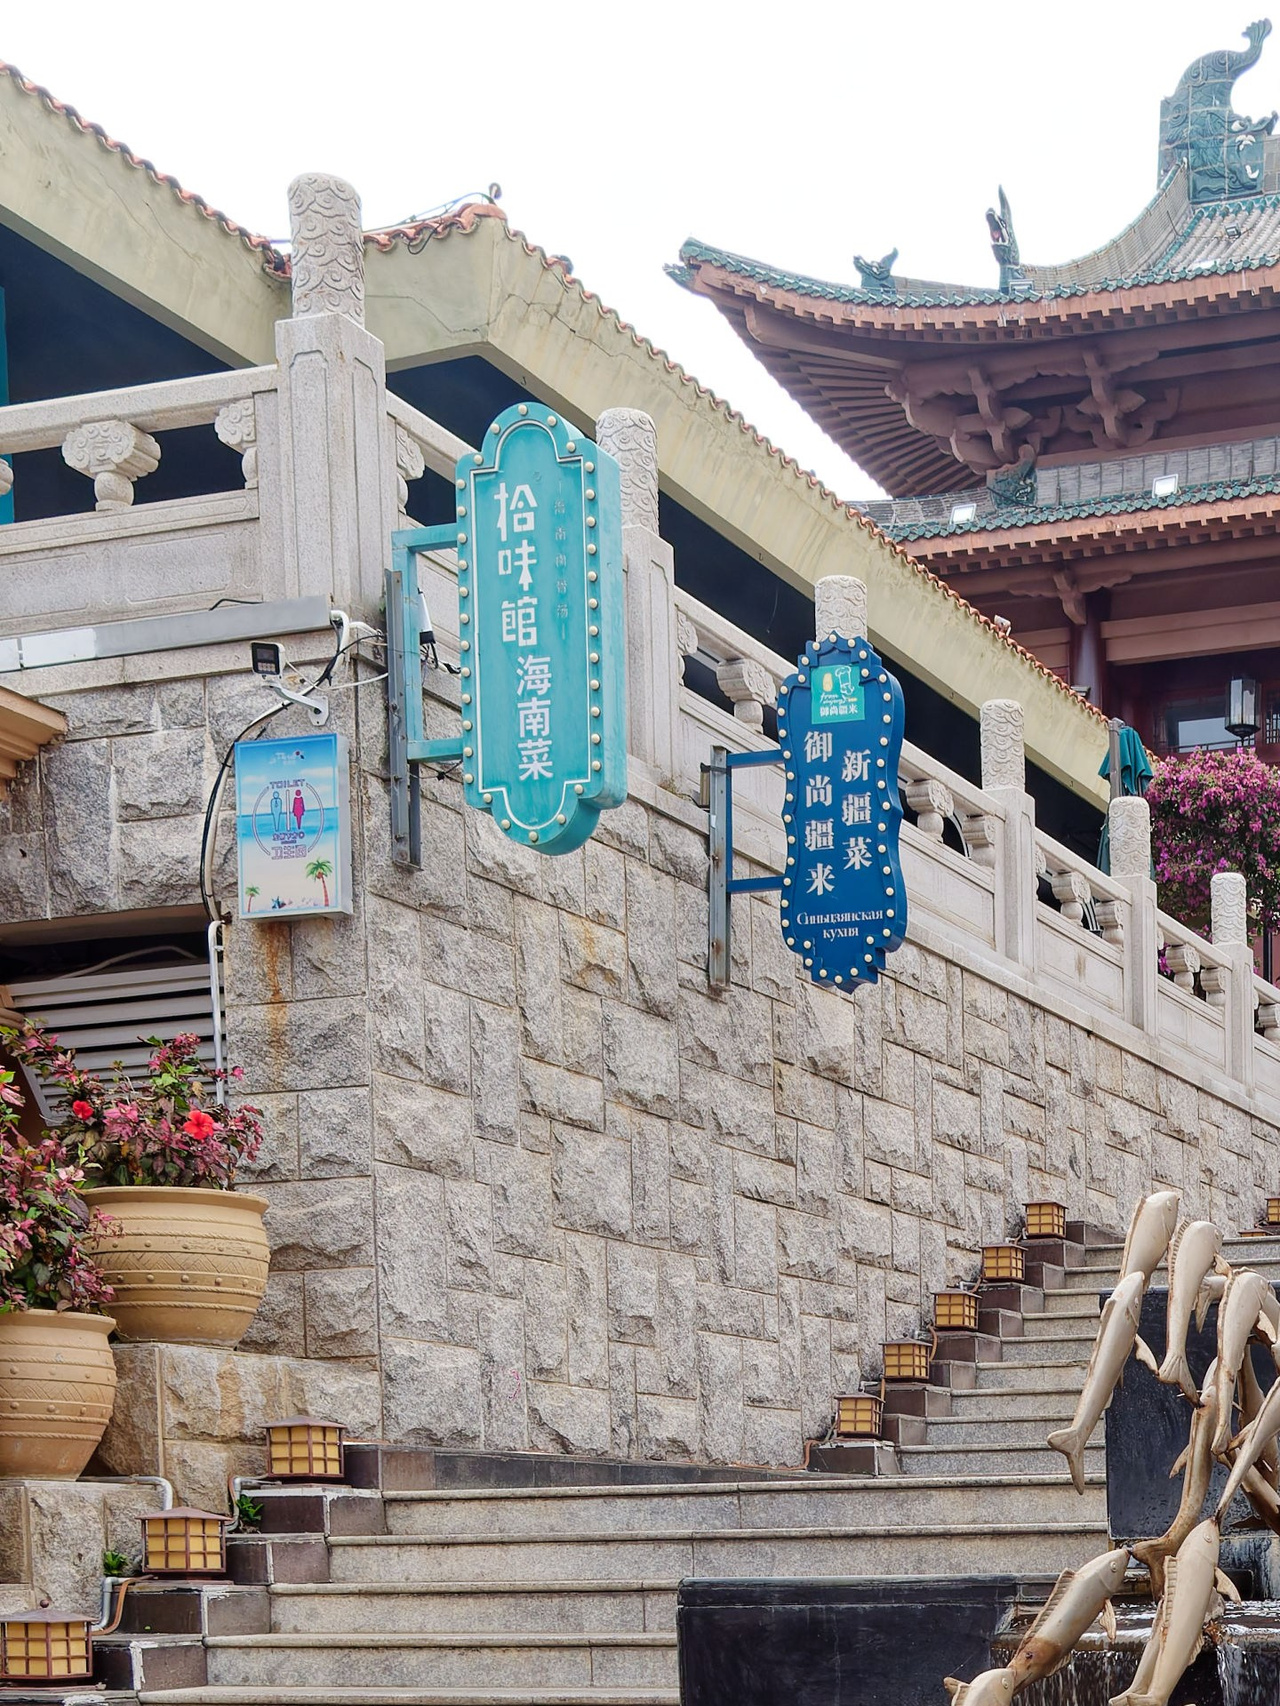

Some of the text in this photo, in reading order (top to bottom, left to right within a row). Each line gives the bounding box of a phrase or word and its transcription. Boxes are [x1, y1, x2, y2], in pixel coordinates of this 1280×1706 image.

[516, 655, 553, 780] 海南菜
[270, 779, 305, 789] TOILET
[803, 730, 834, 896] 御尚疆来
[841, 748, 873, 870] 新疆菜
[823, 927, 859, 942] кухня
